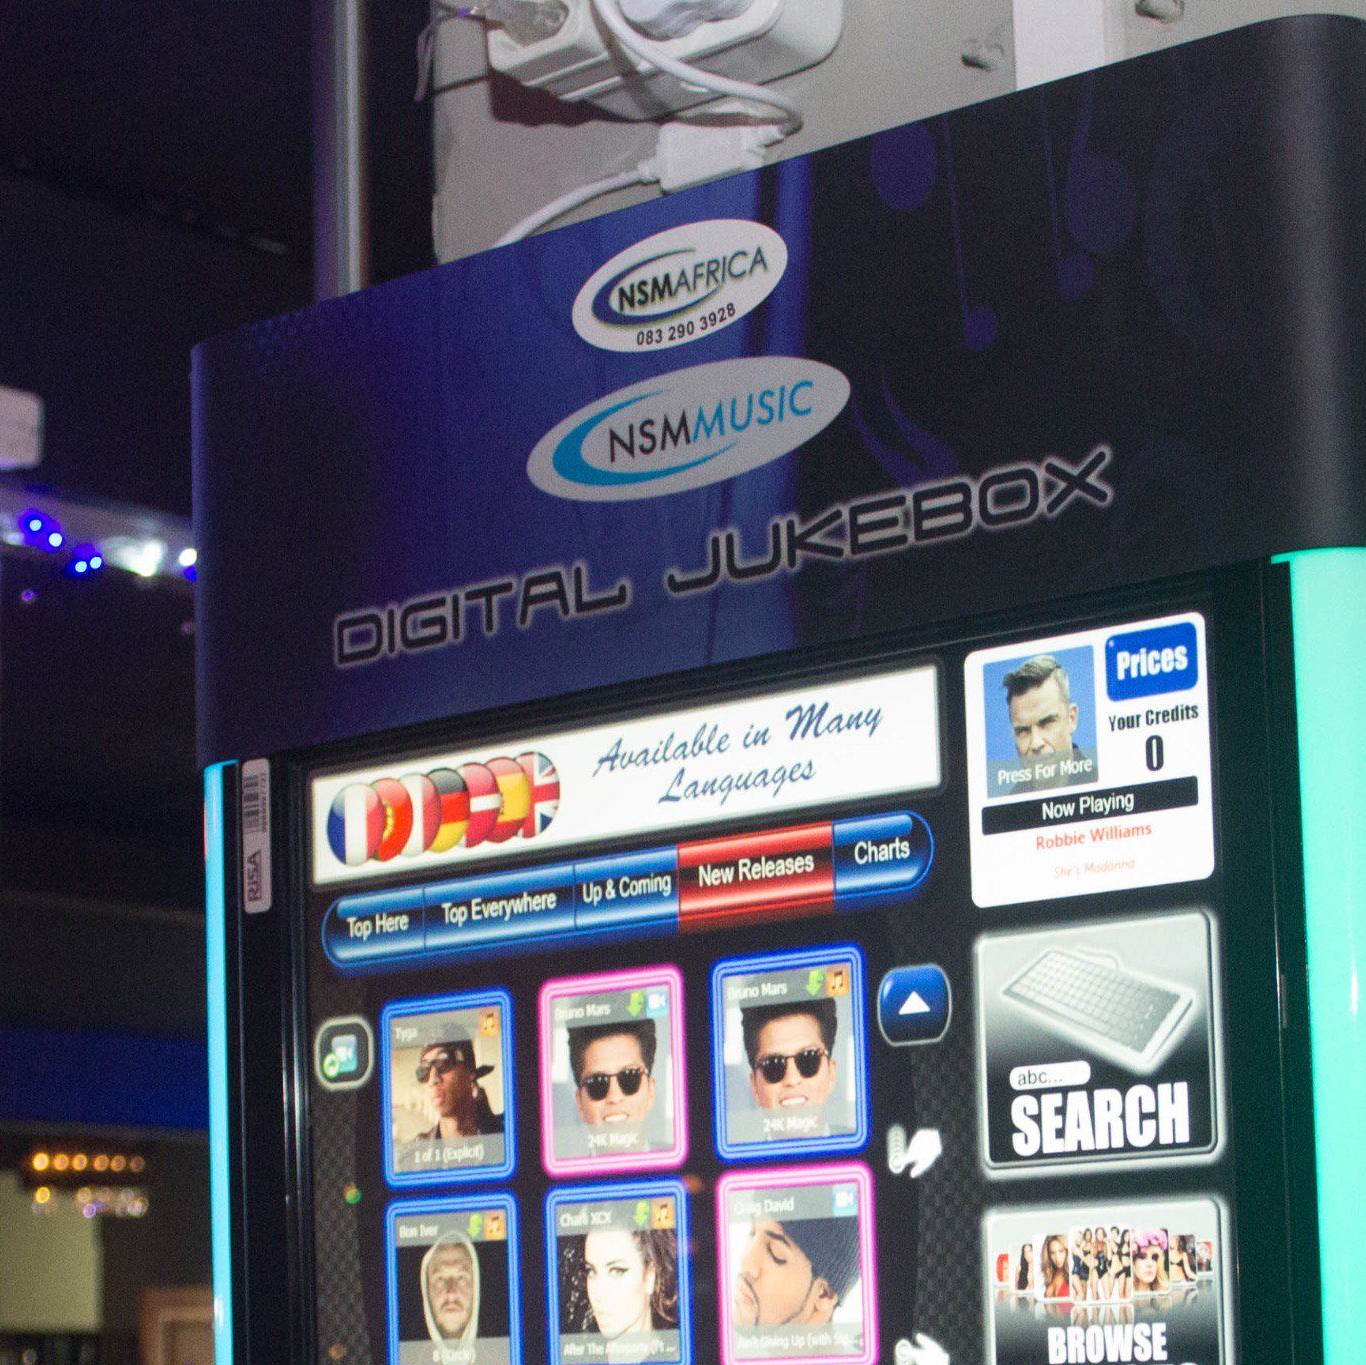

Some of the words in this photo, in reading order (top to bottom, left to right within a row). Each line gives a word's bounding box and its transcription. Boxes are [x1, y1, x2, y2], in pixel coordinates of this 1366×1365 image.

[616, 245, 770, 313] NSMAFRICA
[636, 328, 663, 346] 083
[668, 320, 695, 341] 290
[700, 302, 736, 331] 3928
[608, 379, 815, 463] NSMMUSIC
[334, 565, 627, 667] DIGITAL
[666, 445, 1114, 598] JUKEBOX
[1116, 645, 1189, 681] Prices
[1109, 713, 1141, 732] Your
[1146, 704, 1199, 726] Credits
[592, 722, 732, 777] Available
[742, 723, 772, 749] in
[785, 701, 884, 741] Many
[1146, 734, 1164, 771] 0
[657, 758, 817, 806] Languages
[997, 767, 1032, 785] Press
[1035, 763, 1057, 780] For
[1059, 758, 1093, 775] More
[1041, 801, 1074, 820] Now
[1079, 793, 1135, 814] Playing
[853, 838, 911, 867] Charts
[1036, 832, 1085, 850] Robbie
[1089, 823, 1152, 841] Williams
[697, 863, 733, 887] New
[737, 851, 815, 882] Releases
[582, 881, 600, 906] Up
[602, 881, 612, 900] &
[614, 871, 672, 903] Coming
[347, 915, 371, 941] Top
[374, 911, 409, 933] Here
[441, 903, 467, 929] Top
[470, 888, 558, 923] Everywhere
[762, 981, 788, 996] Mars
[1011, 1081, 1190, 1157] SEARCH
[763, 1197, 795, 1211] David
[1047, 1322, 1168, 1365] BROWSE
